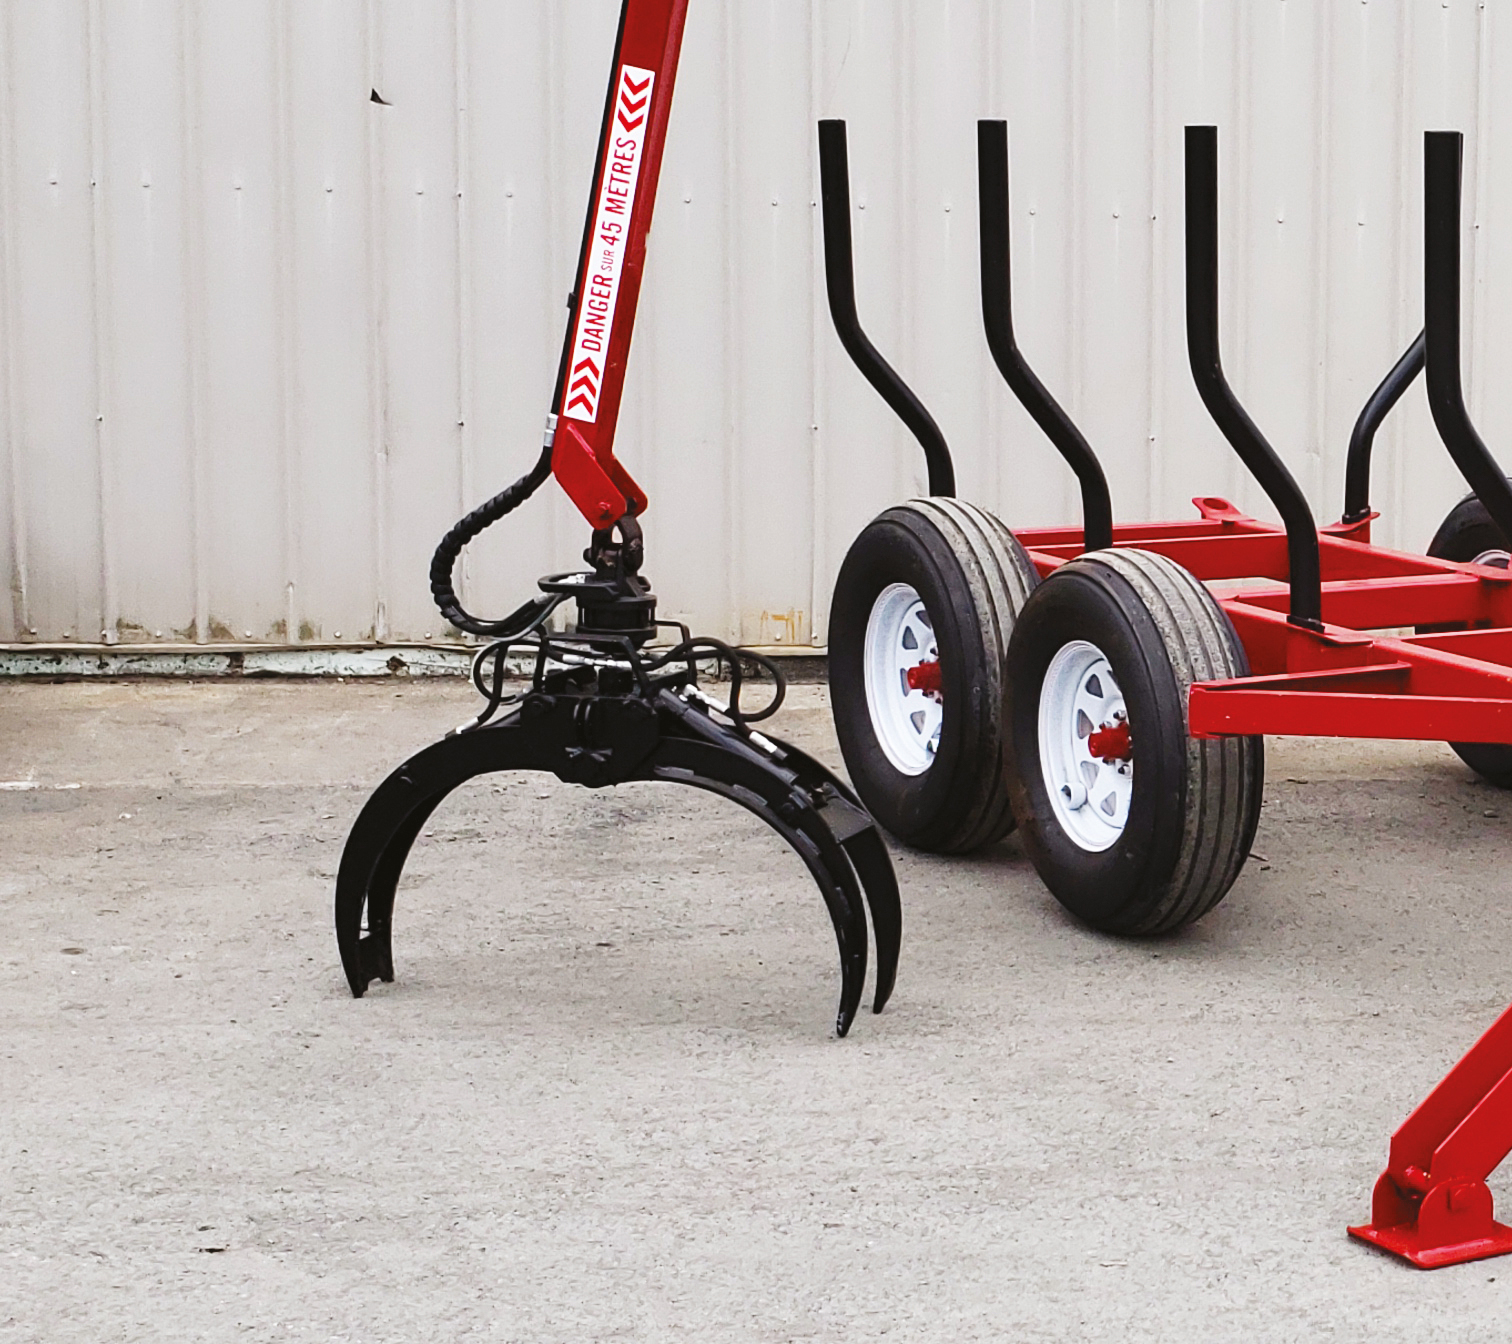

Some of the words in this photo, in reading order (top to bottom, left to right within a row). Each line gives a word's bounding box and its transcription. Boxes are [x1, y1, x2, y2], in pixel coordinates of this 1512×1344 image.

[604, 137, 636, 215] MÈTRES
[600, 221, 622, 246] 45
[600, 249, 615, 271] SUR
[581, 273, 613, 352] DANGER
